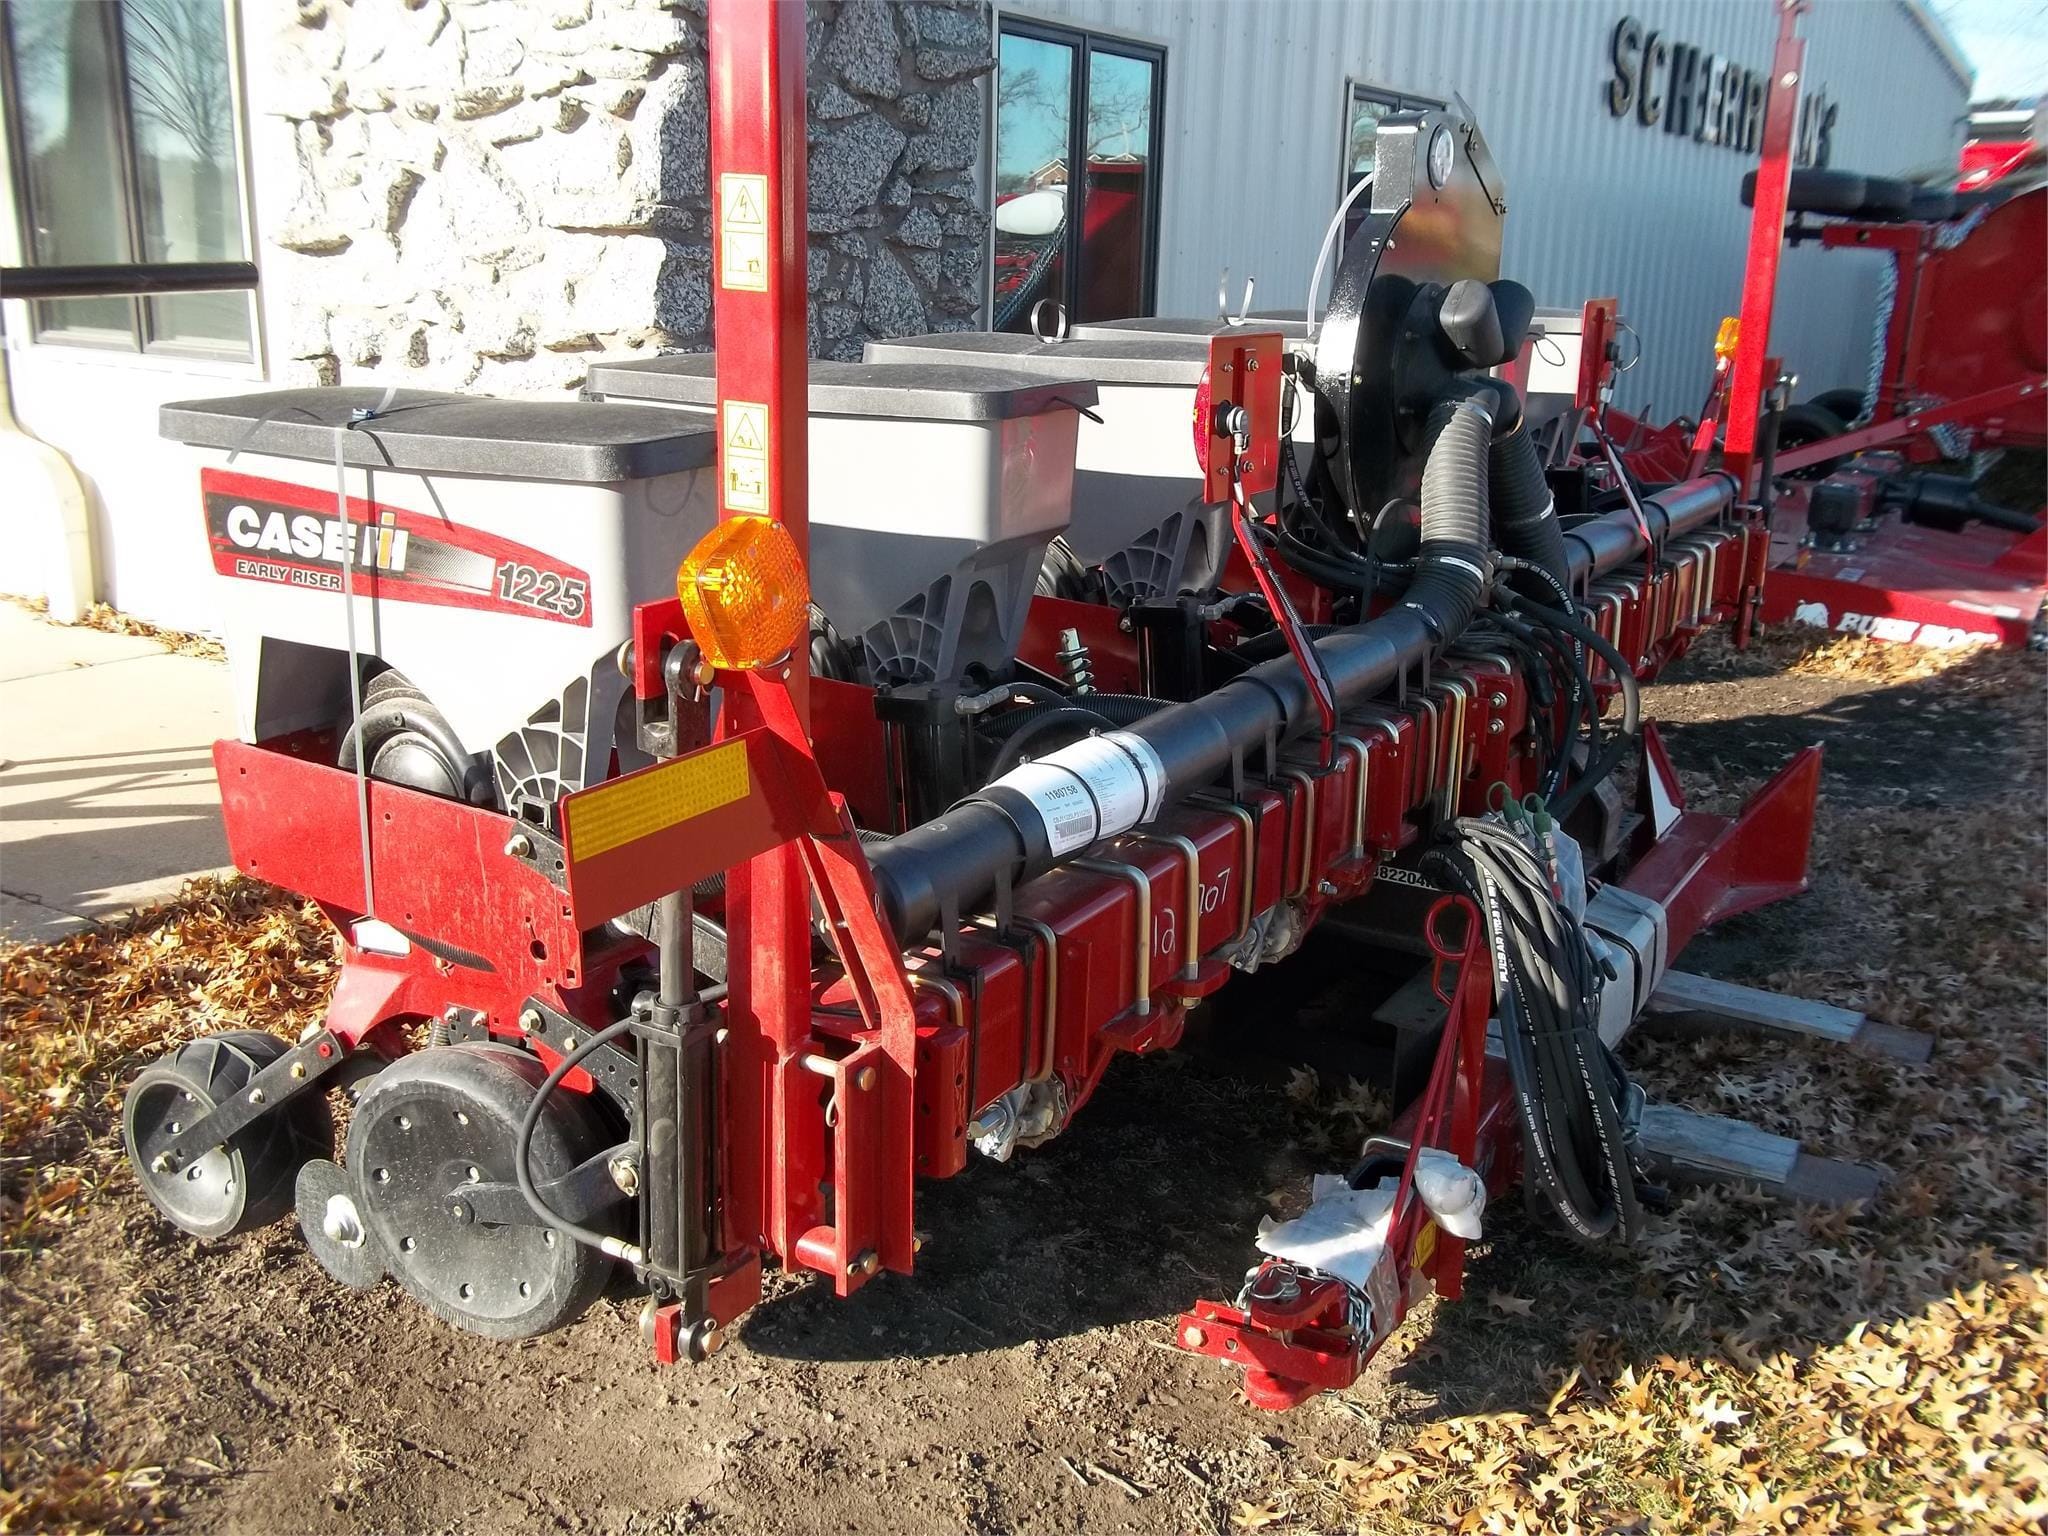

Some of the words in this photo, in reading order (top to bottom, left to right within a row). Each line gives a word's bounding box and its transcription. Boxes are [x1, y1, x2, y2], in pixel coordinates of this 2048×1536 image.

[227, 505, 356, 565] CASE
[236, 559, 289, 581] EARLY
[291, 569, 342, 590] RISER
[498, 561, 586, 619] 1225
[1044, 784, 1079, 801] 1180758
